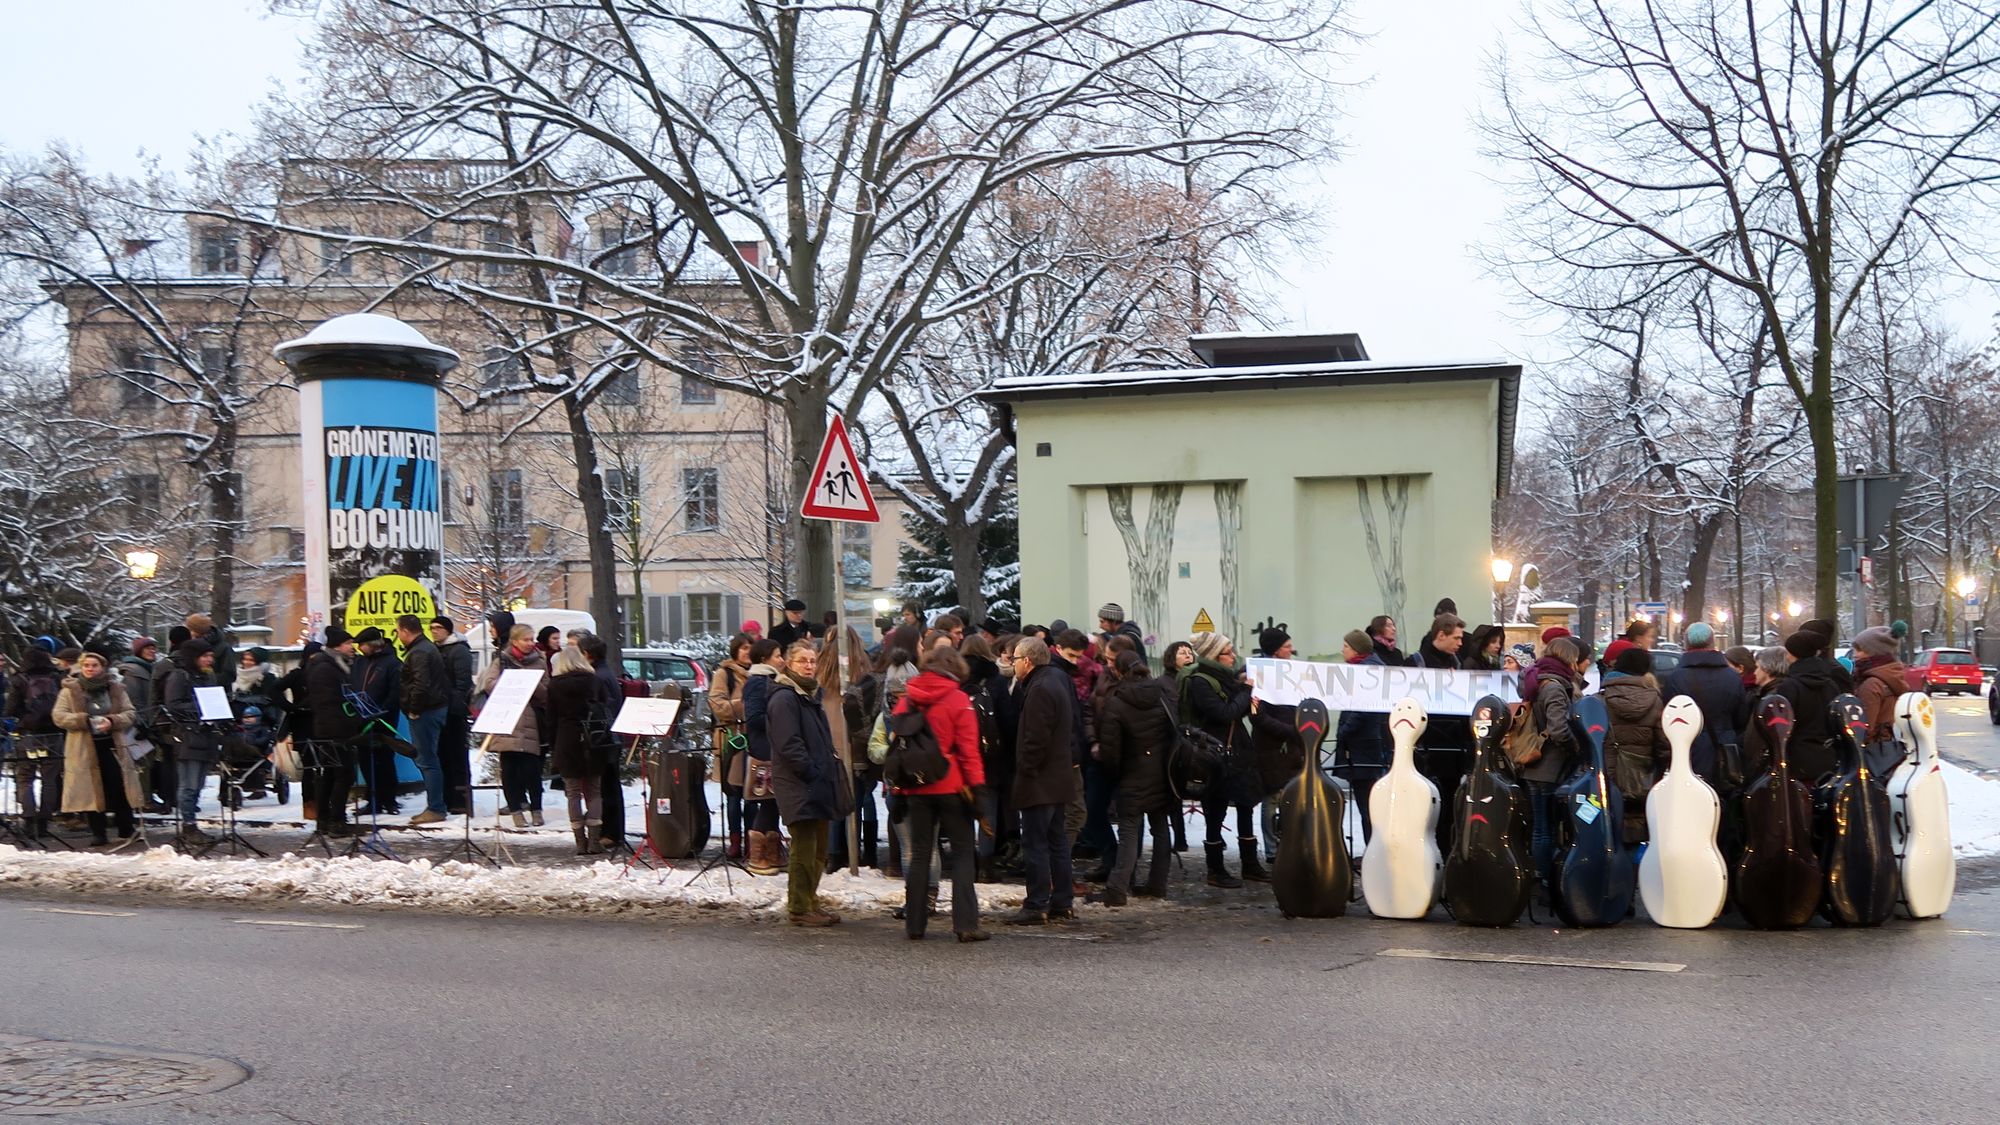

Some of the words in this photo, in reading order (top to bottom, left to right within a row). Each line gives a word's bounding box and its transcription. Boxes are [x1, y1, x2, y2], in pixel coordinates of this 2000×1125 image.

[329, 455, 408, 510] LIVE
[411, 457, 437, 512] IN
[329, 507, 440, 550] BOCHUM
[358, 591, 387, 614] AUF
[392, 590, 427, 614] 2CDs
